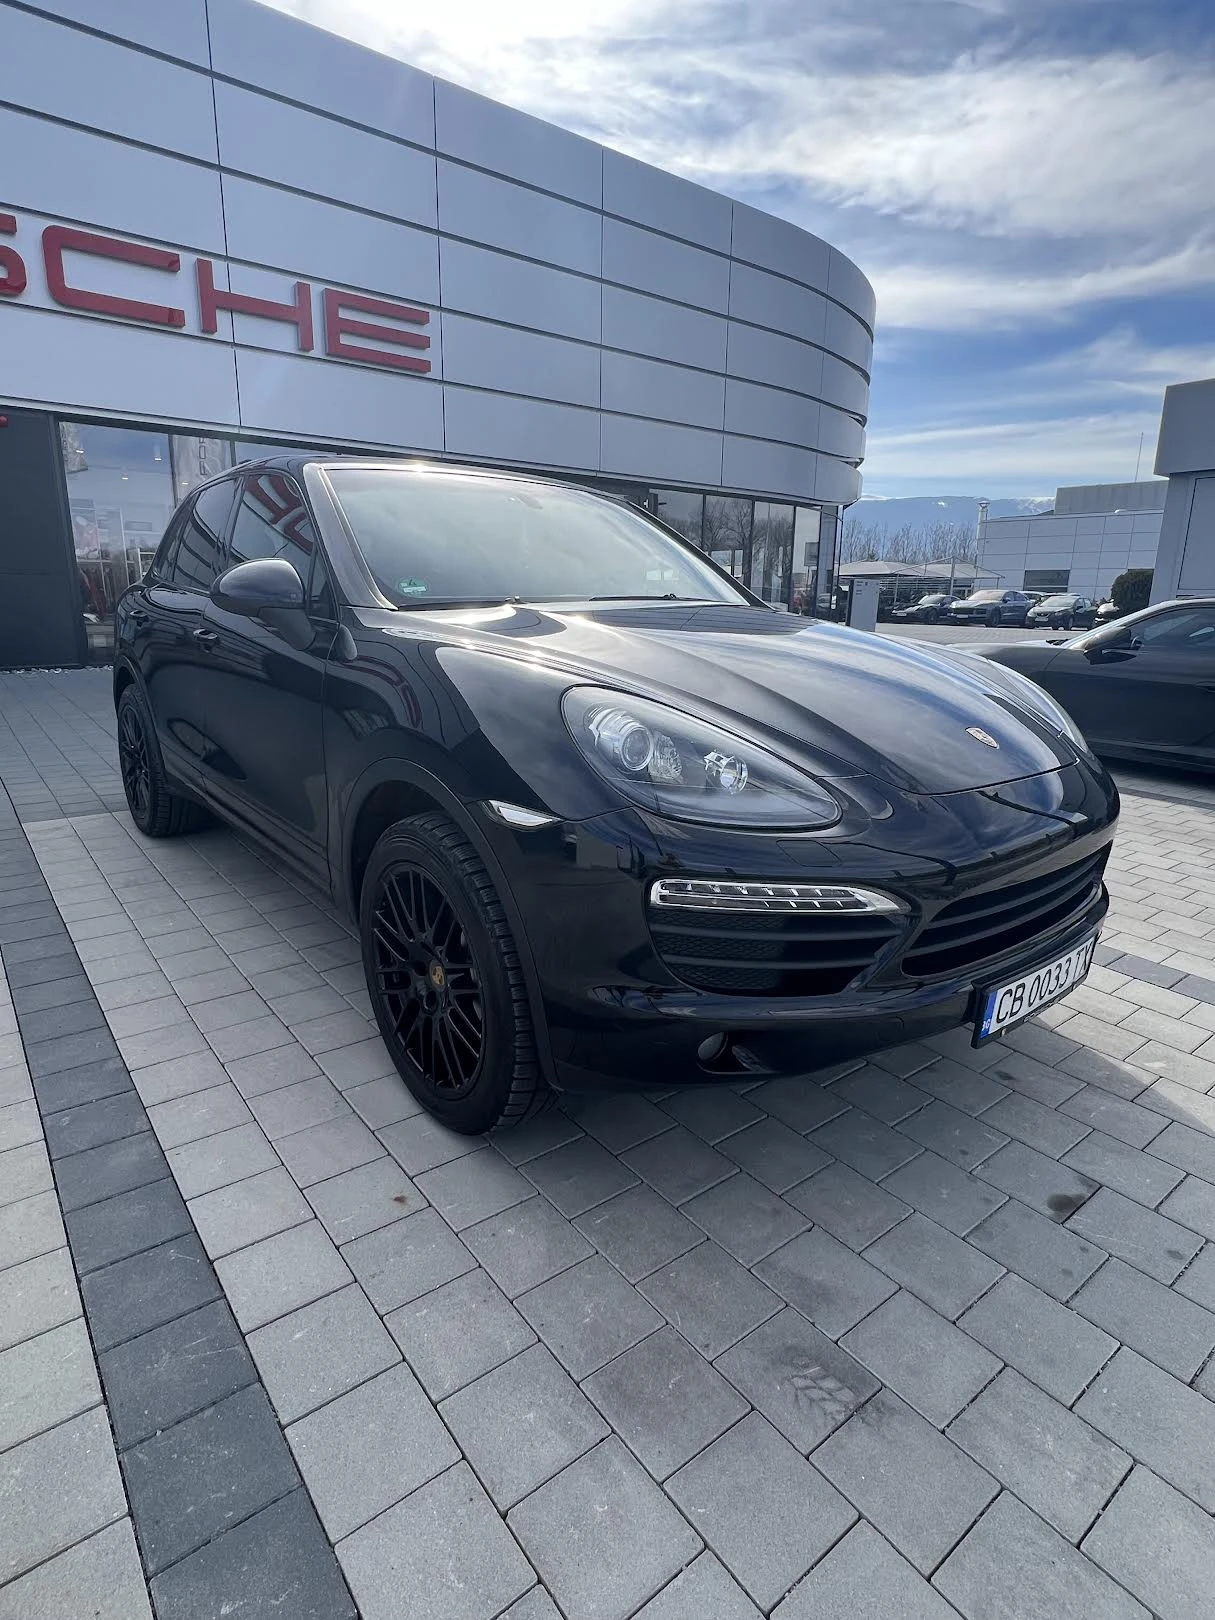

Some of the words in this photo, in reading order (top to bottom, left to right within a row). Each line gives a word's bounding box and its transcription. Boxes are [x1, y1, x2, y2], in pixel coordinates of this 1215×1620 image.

[0, 212, 432, 374] CHE
[995, 982, 1026, 1024] CB
[1027, 956, 1072, 1008] 0033
